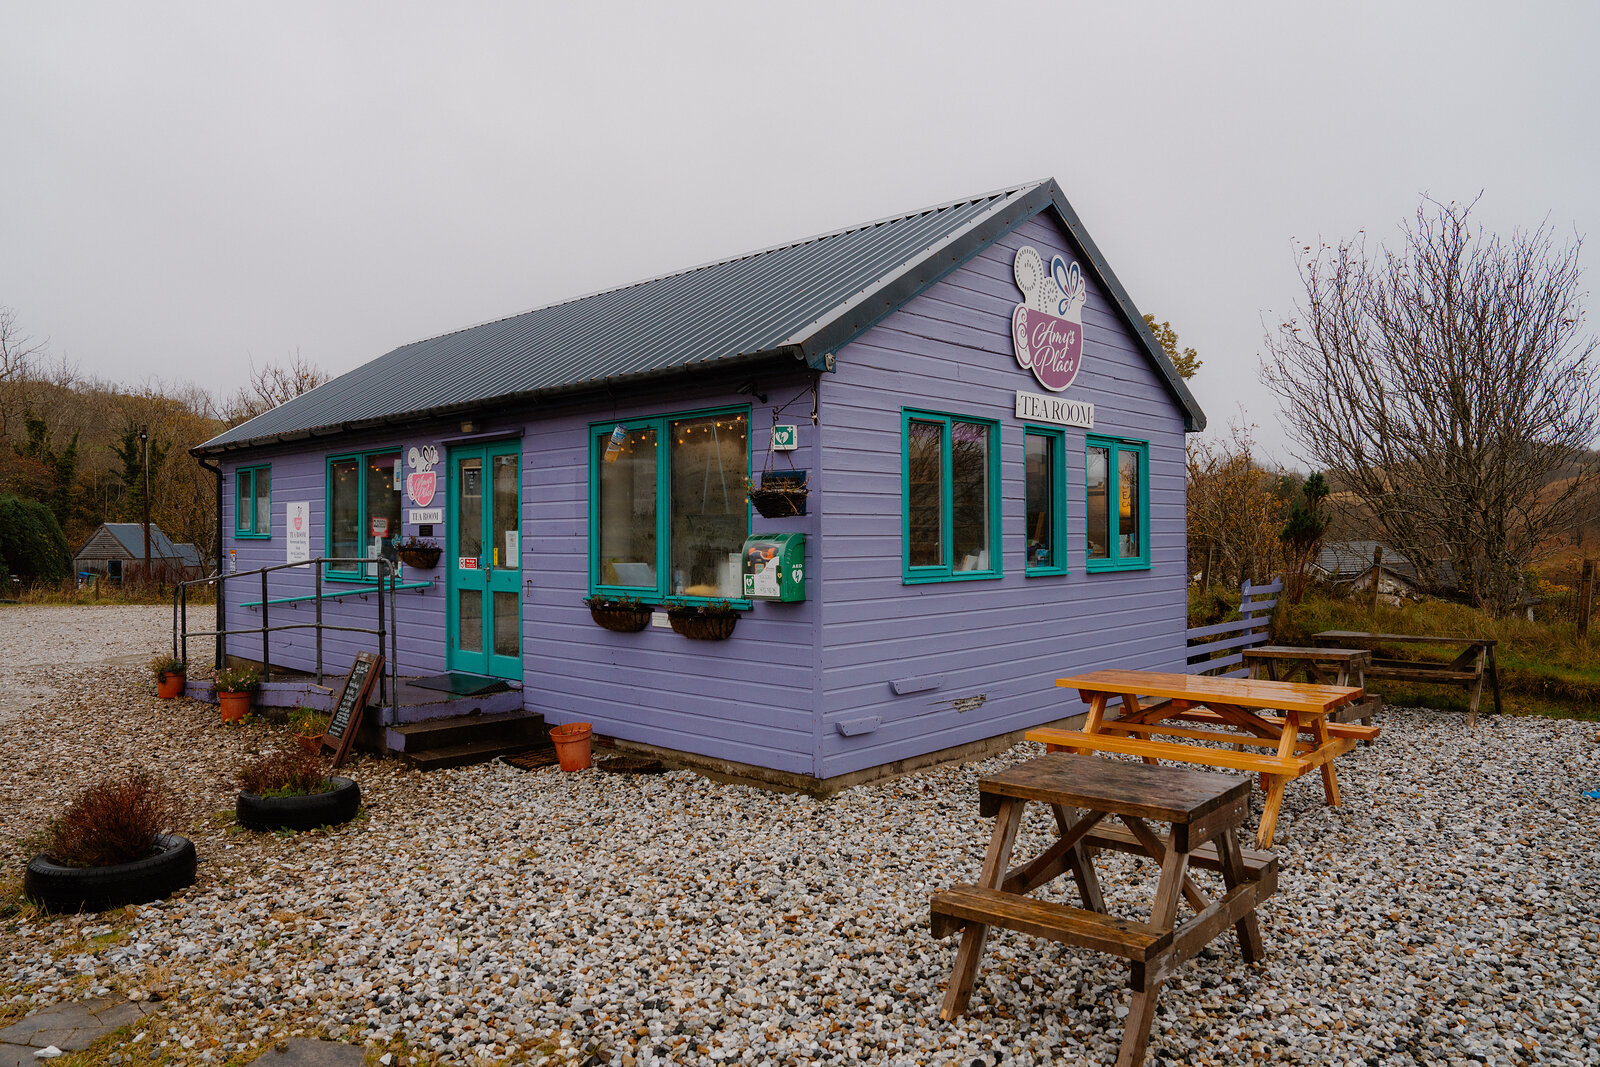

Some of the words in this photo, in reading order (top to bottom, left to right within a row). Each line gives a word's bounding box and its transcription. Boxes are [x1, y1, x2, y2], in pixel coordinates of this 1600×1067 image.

[1032, 320, 1075, 359] Amy's
[1034, 345, 1073, 376] Place
[1020, 395, 1049, 419] TEA
[1052, 401, 1091, 425] ROOM
[412, 512, 422, 521] TEA
[423, 511, 439, 521] ROOM
